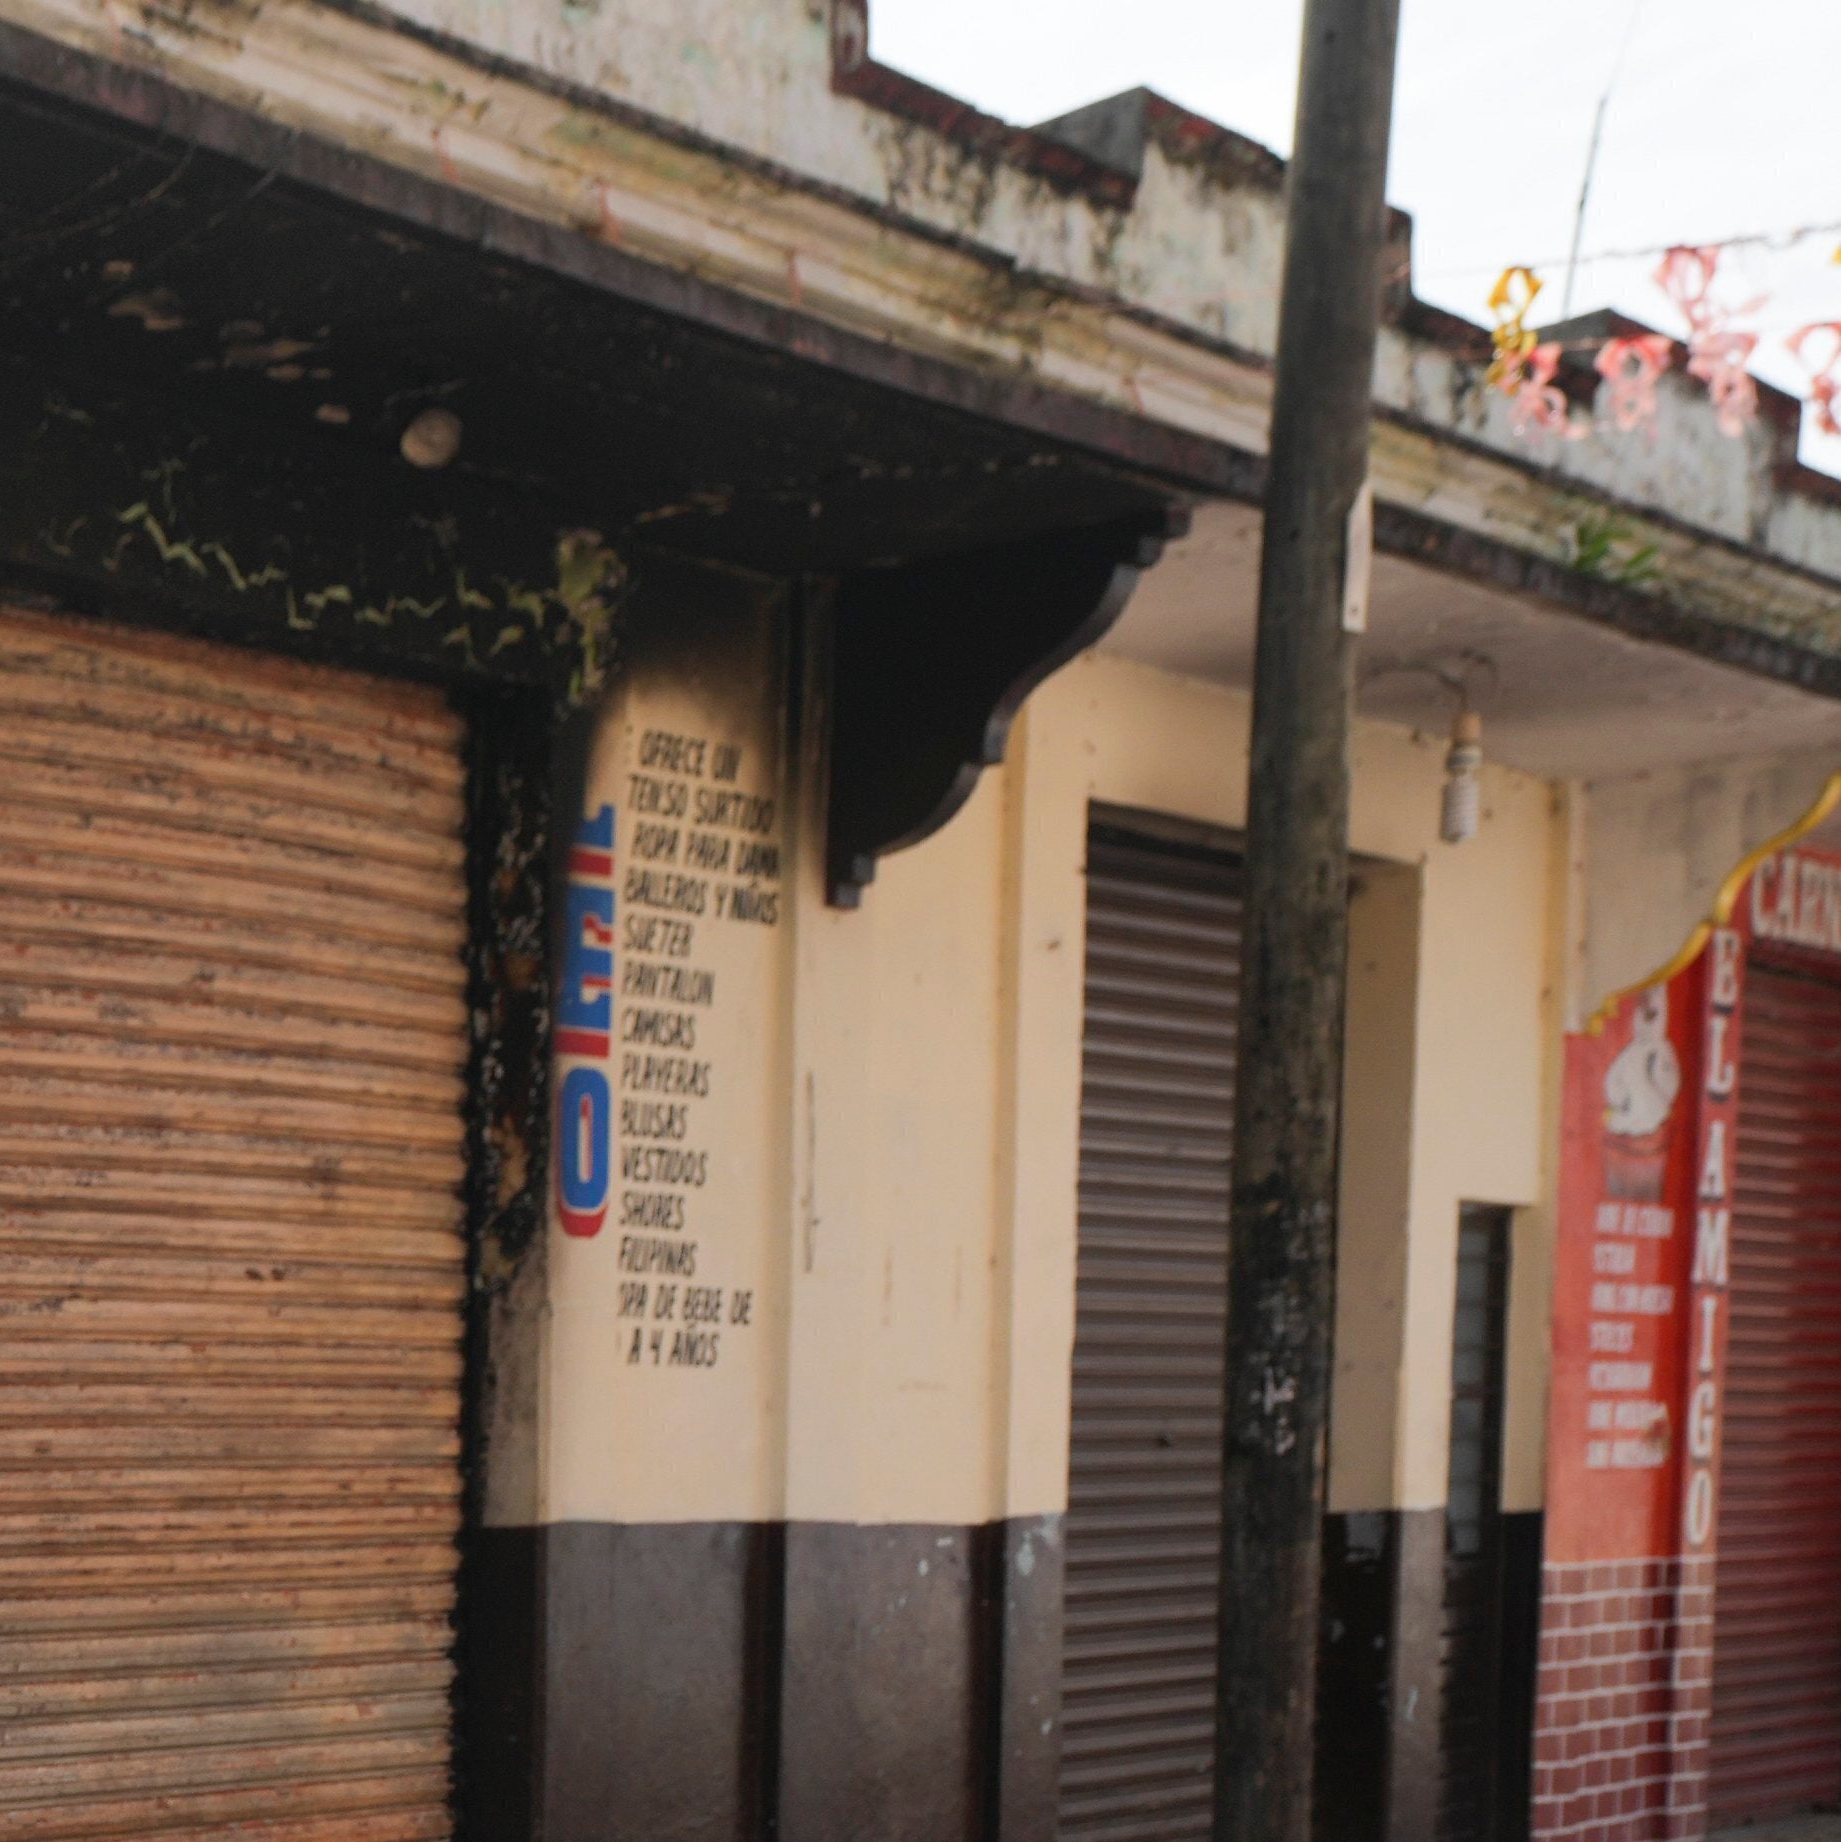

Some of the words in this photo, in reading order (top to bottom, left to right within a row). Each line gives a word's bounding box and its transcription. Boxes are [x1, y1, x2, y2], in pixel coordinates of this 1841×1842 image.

[638, 728, 706, 778] OFRECE
[628, 772, 689, 819] TENSO
[683, 830, 731, 872] PARA
[623, 867, 709, 917] BALLEROS
[714, 884, 728, 918] Y
[622, 913, 694, 958] SUETER
[621, 959, 716, 1007] PANTALON
[620, 1006, 696, 1051] CAMISAS
[620, 1053, 711, 1098] PLAYERAS
[621, 1098, 689, 1141] BLUSAS
[621, 1146, 709, 1187] VESTIDOS
[618, 1234, 698, 1277] FILIPINAS
[652, 1283, 678, 1320] DE
[682, 1286, 723, 1323] BEBE
[729, 1289, 754, 1326] DE
[626, 1327, 643, 1365] A
[650, 1328, 664, 1365] 4
[667, 1321, 721, 1368] AÑOS
